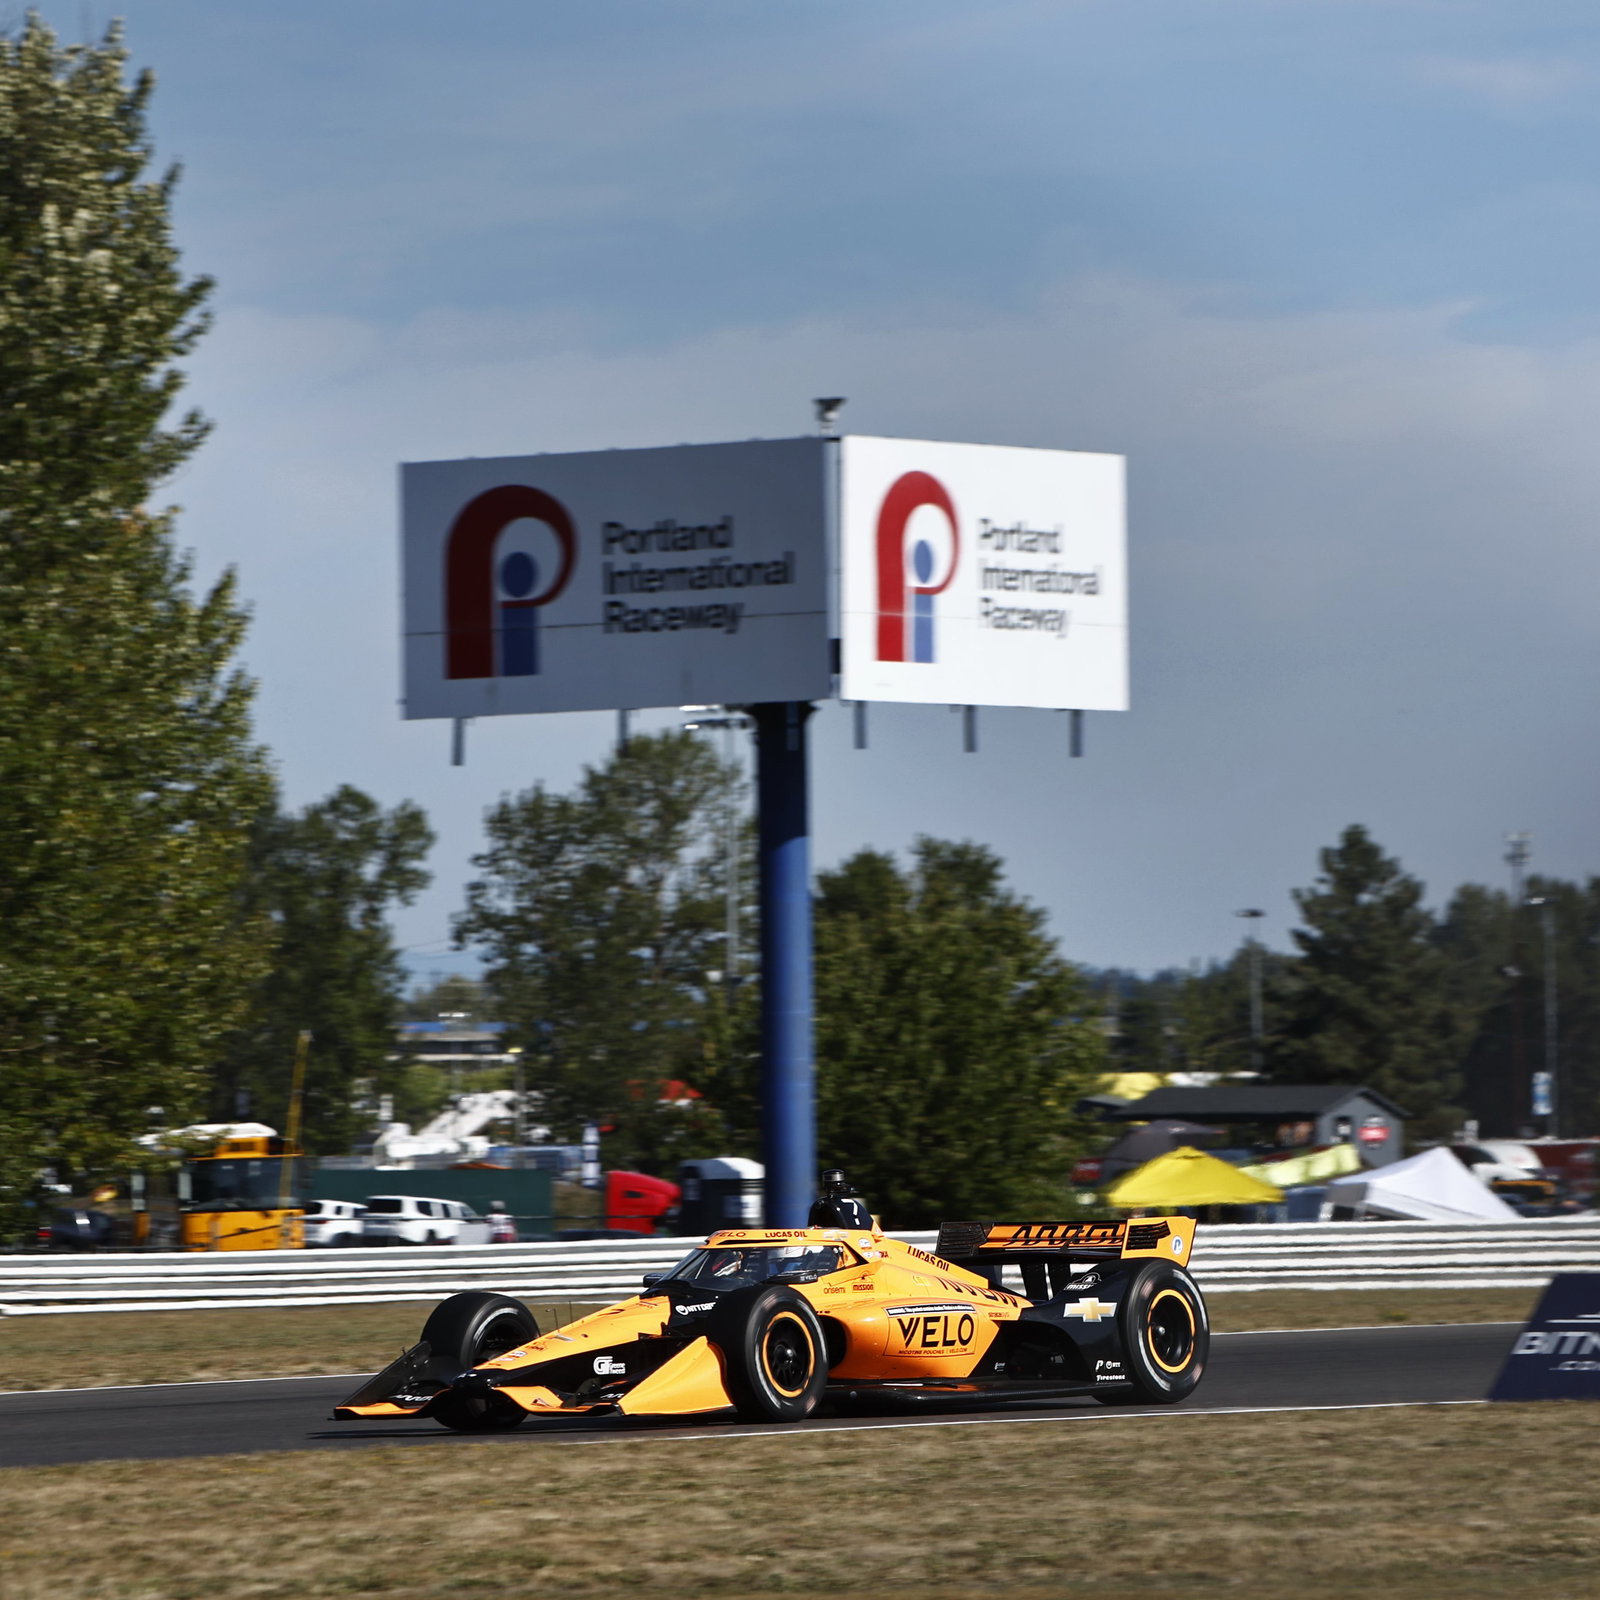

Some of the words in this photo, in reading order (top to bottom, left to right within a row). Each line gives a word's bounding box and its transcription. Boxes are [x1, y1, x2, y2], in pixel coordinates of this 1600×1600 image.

[602, 516, 734, 555] Portland
[978, 518, 1063, 554] Portland
[603, 551, 795, 595] International
[978, 558, 1103, 595] International
[603, 601, 744, 634] Raceway
[978, 597, 1071, 639] Raceway
[840, 1198, 860, 1226] 7
[764, 1231, 793, 1239] LUCAS
[793, 1230, 808, 1238] OIL
[907, 1245, 936, 1266] LUCAS
[823, 1285, 846, 1294] onsemi
[852, 1283, 875, 1291] mission
[896, 1313, 975, 1349] VELO
